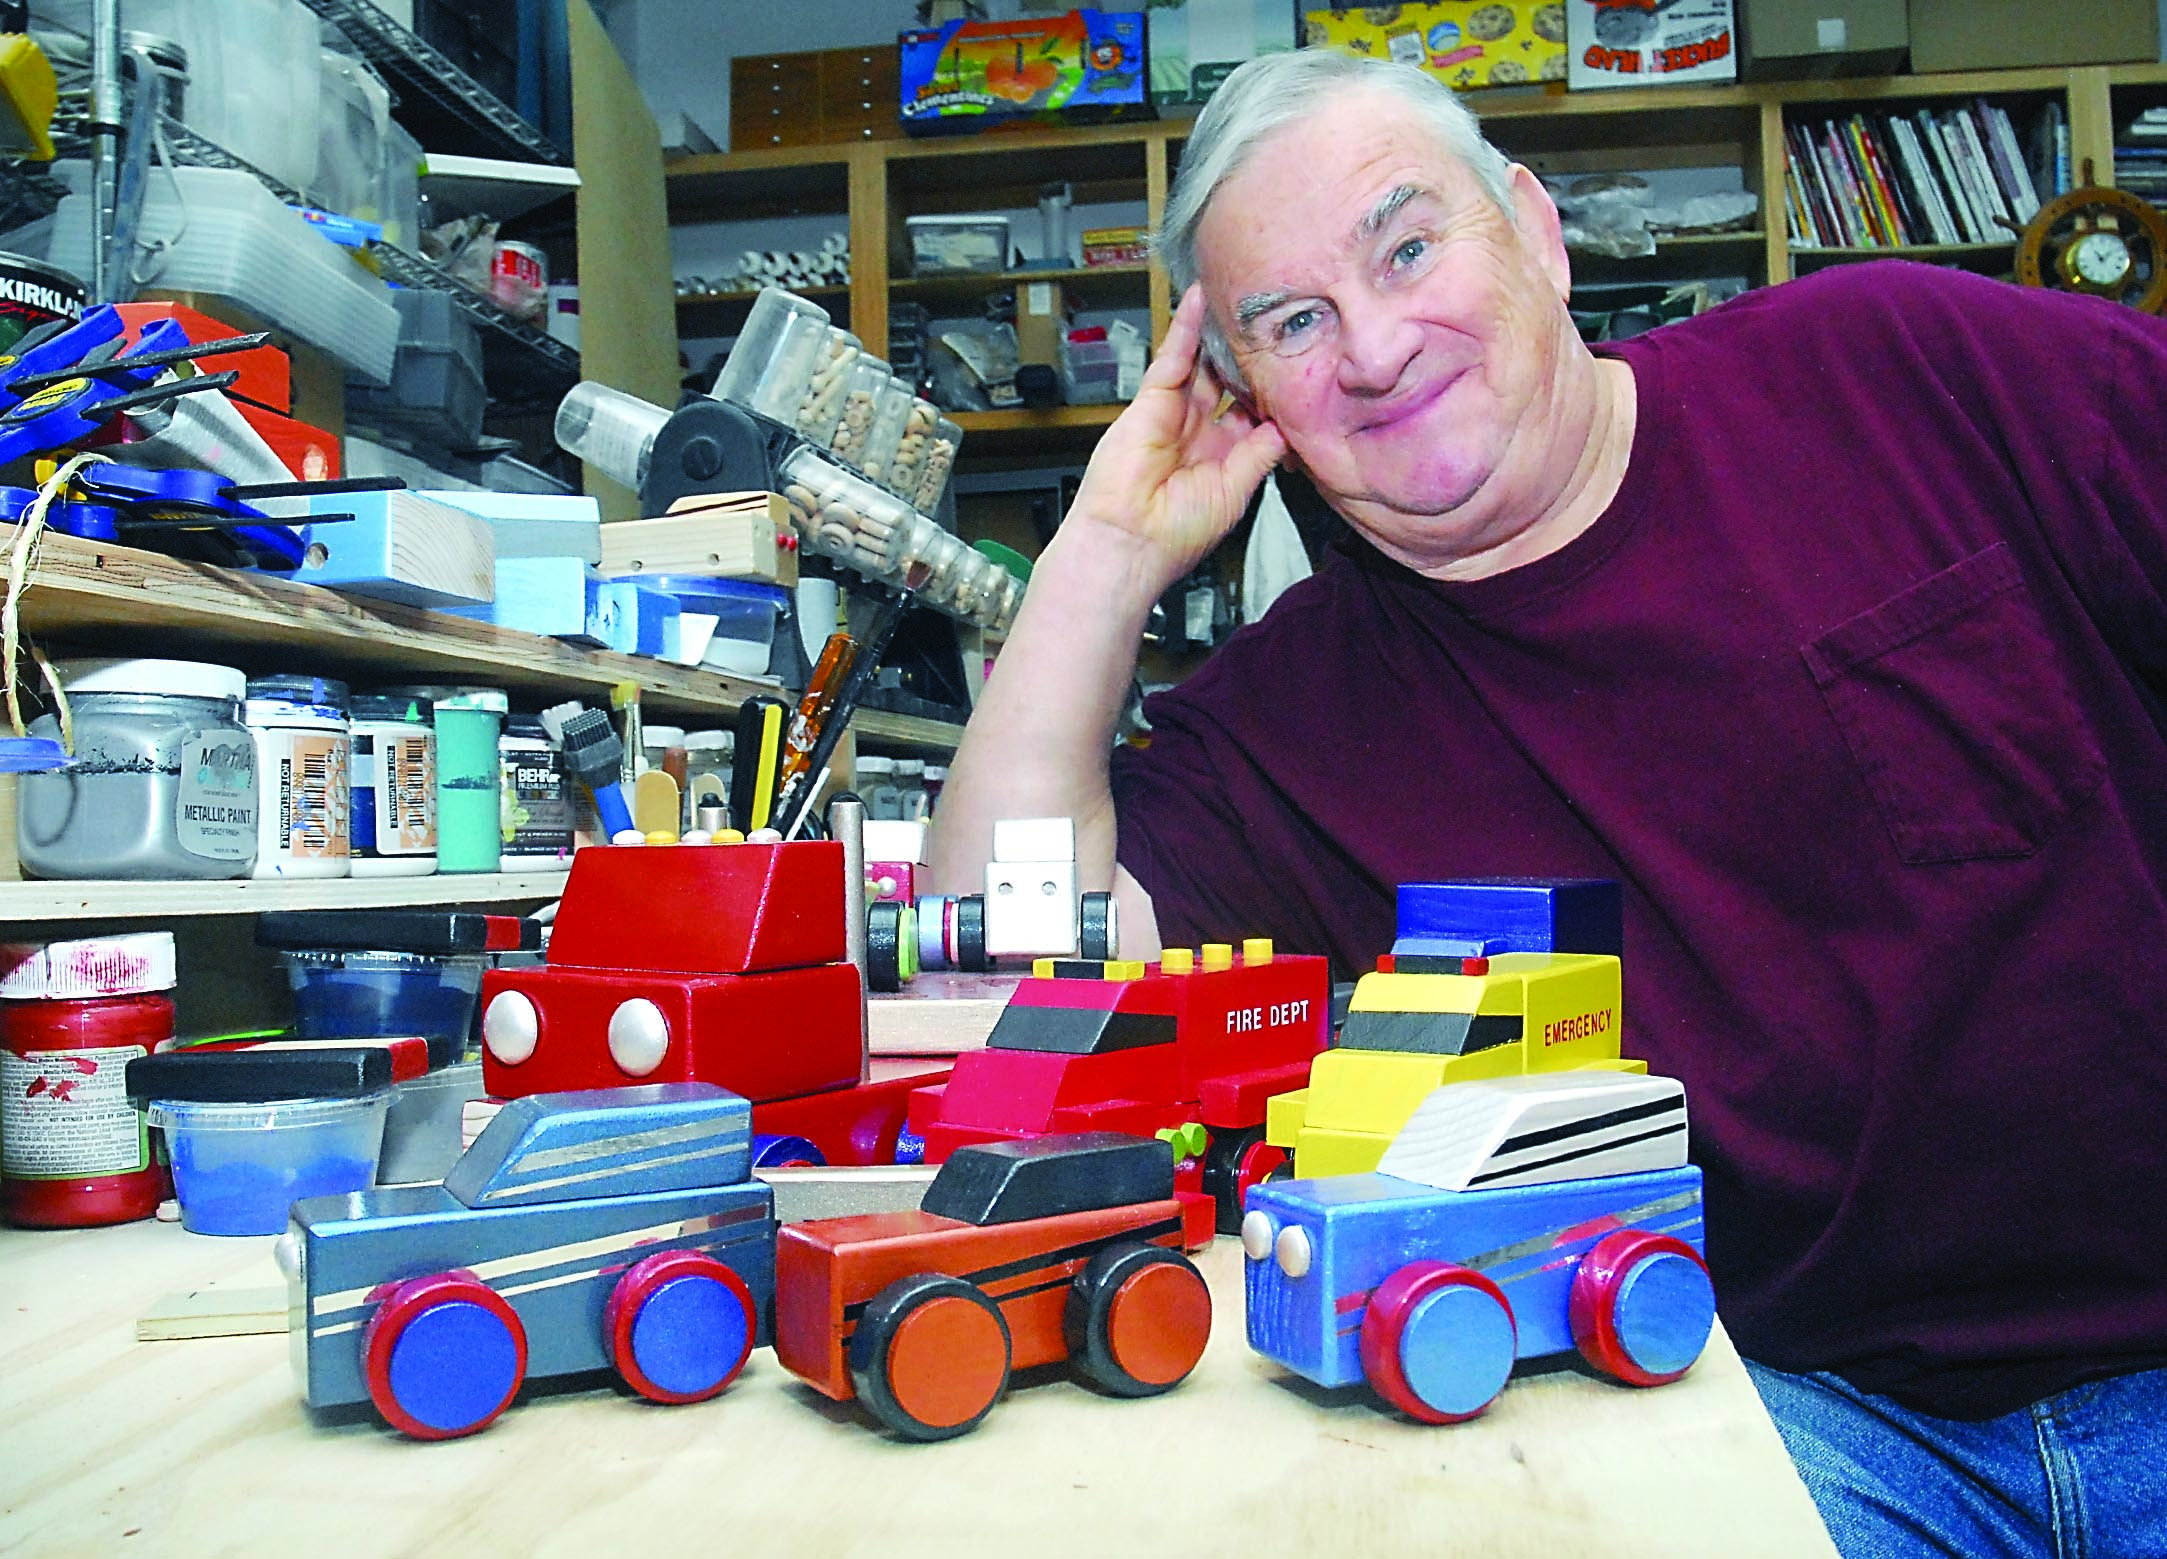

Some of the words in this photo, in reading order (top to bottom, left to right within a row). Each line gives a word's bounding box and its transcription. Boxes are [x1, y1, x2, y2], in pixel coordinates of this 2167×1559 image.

[387, 750, 395, 768] NOT
[281, 763, 290, 783] NOT
[517, 768, 550, 783] BEHR
[517, 782, 548, 790] PREMIUM
[388, 769, 398, 826] RETURNABLE
[184, 804, 225, 822] METALLIC
[227, 808, 252, 825] PAINT
[281, 785, 290, 847] RETURNABLE
[1226, 1007, 1263, 1035] FIRE
[1269, 999, 1310, 1028] DEPT
[1544, 1008, 1612, 1047] EMERGENCY
